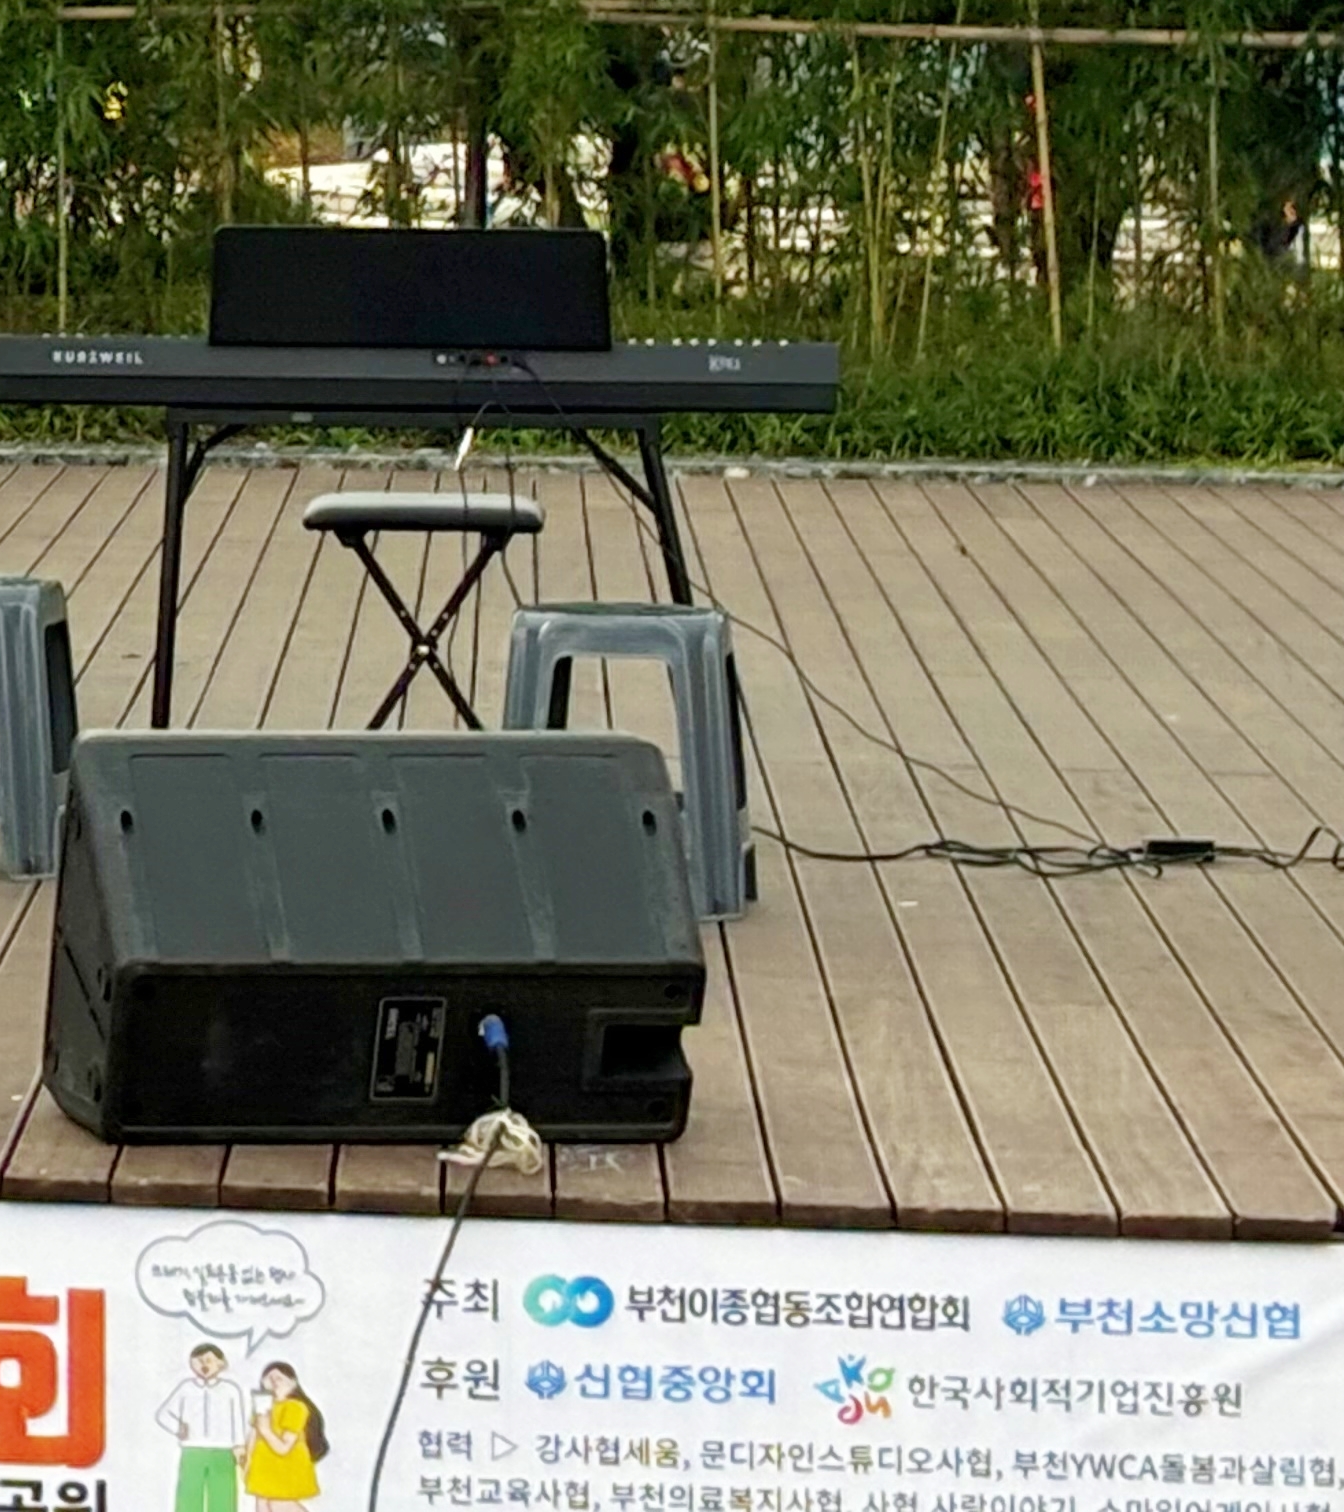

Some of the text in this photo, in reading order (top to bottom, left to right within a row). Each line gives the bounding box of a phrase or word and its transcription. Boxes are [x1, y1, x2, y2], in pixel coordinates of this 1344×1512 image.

[421, 1277, 1300, 1339] 주최 부천이종협동조합연합회 부천소망신협
[420, 1356, 776, 1405] 후원 신협중앙회
[908, 1375, 1243, 1418] 한국사회적기업진흥원
[418, 1429, 474, 1462] 협력
[700, 1440, 1003, 1481] 문디자인스튜디오사협,
[609, 1482, 850, 1512] 부천의료복지사협
